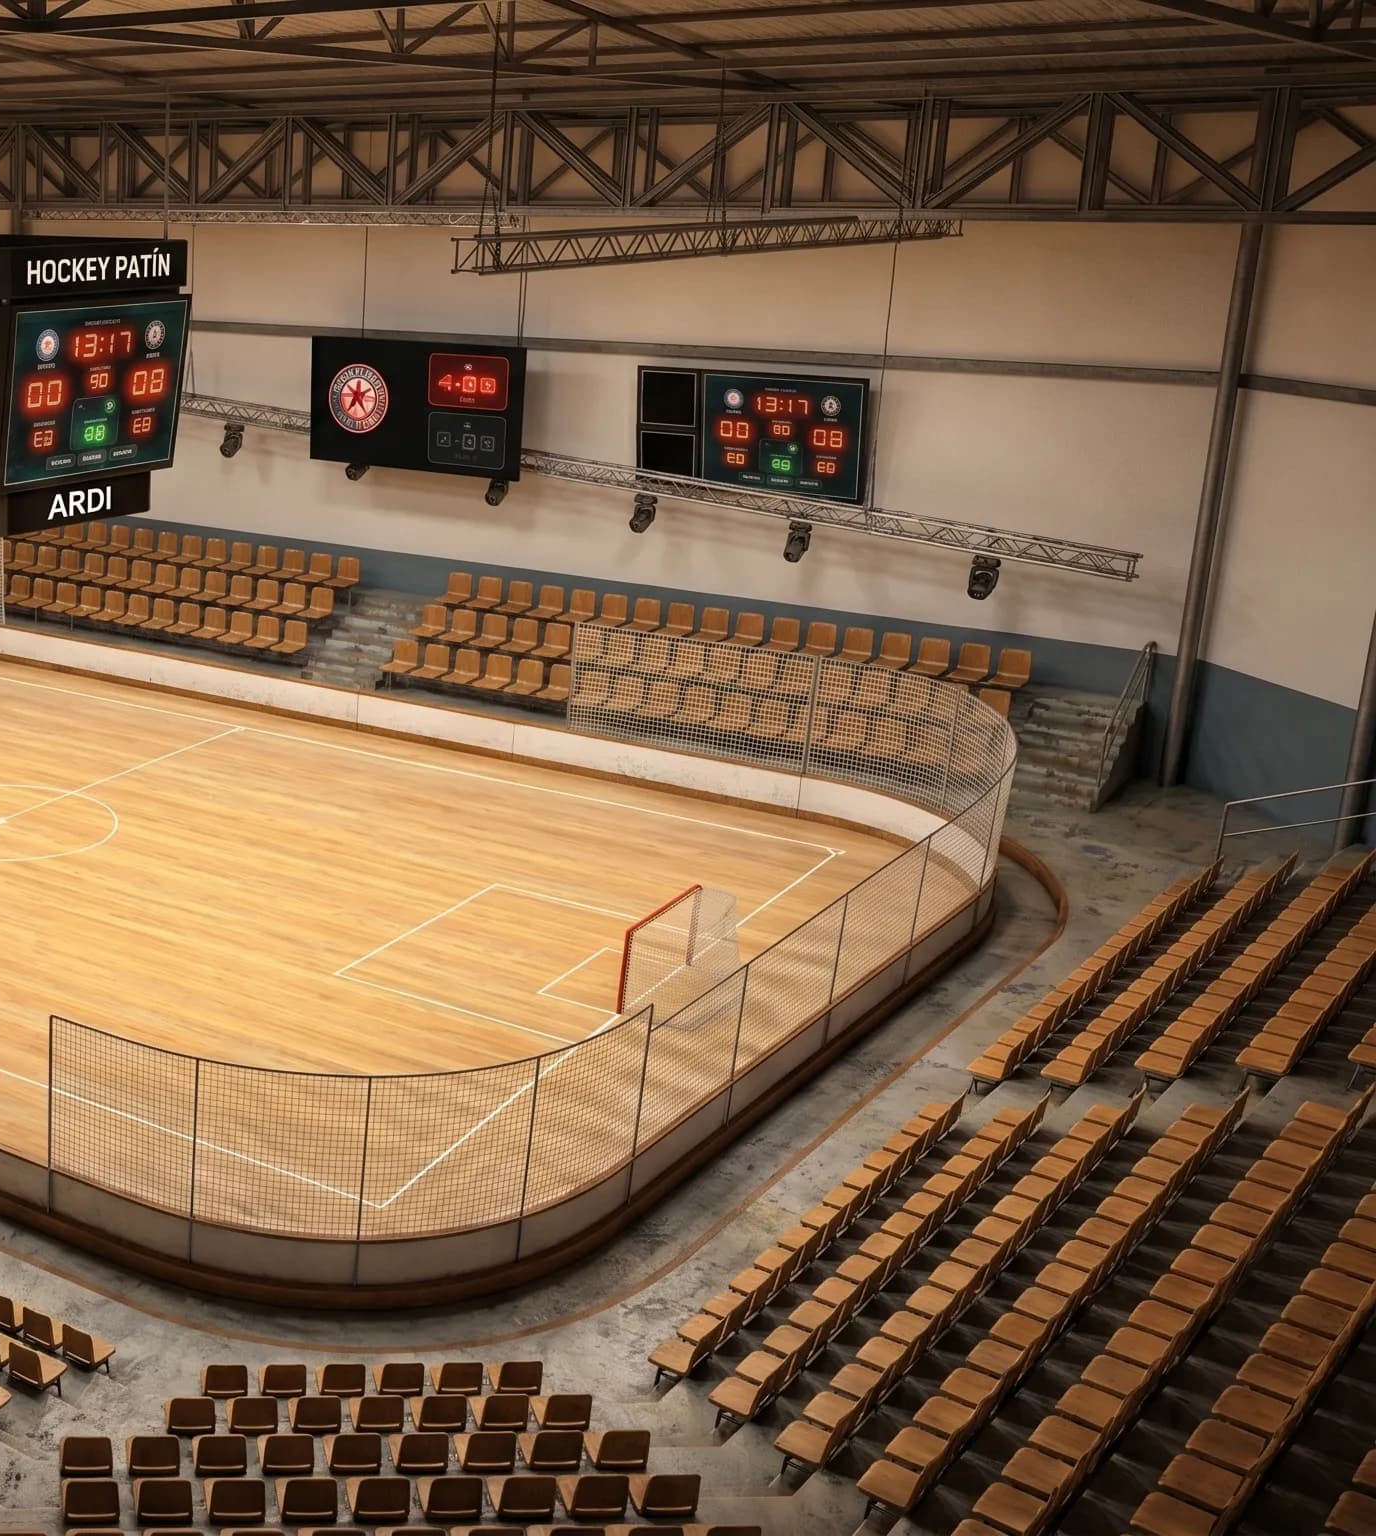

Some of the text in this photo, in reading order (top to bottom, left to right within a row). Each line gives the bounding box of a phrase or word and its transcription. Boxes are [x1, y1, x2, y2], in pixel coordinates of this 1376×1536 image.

[26, 248, 170, 285] HOCKEY PATÍN
[75, 331, 132, 358] 13:17
[27, 380, 62, 408] 00
[132, 368, 164, 395] 08
[756, 396, 808, 415] 13:17
[47, 486, 112, 520] ARDI
